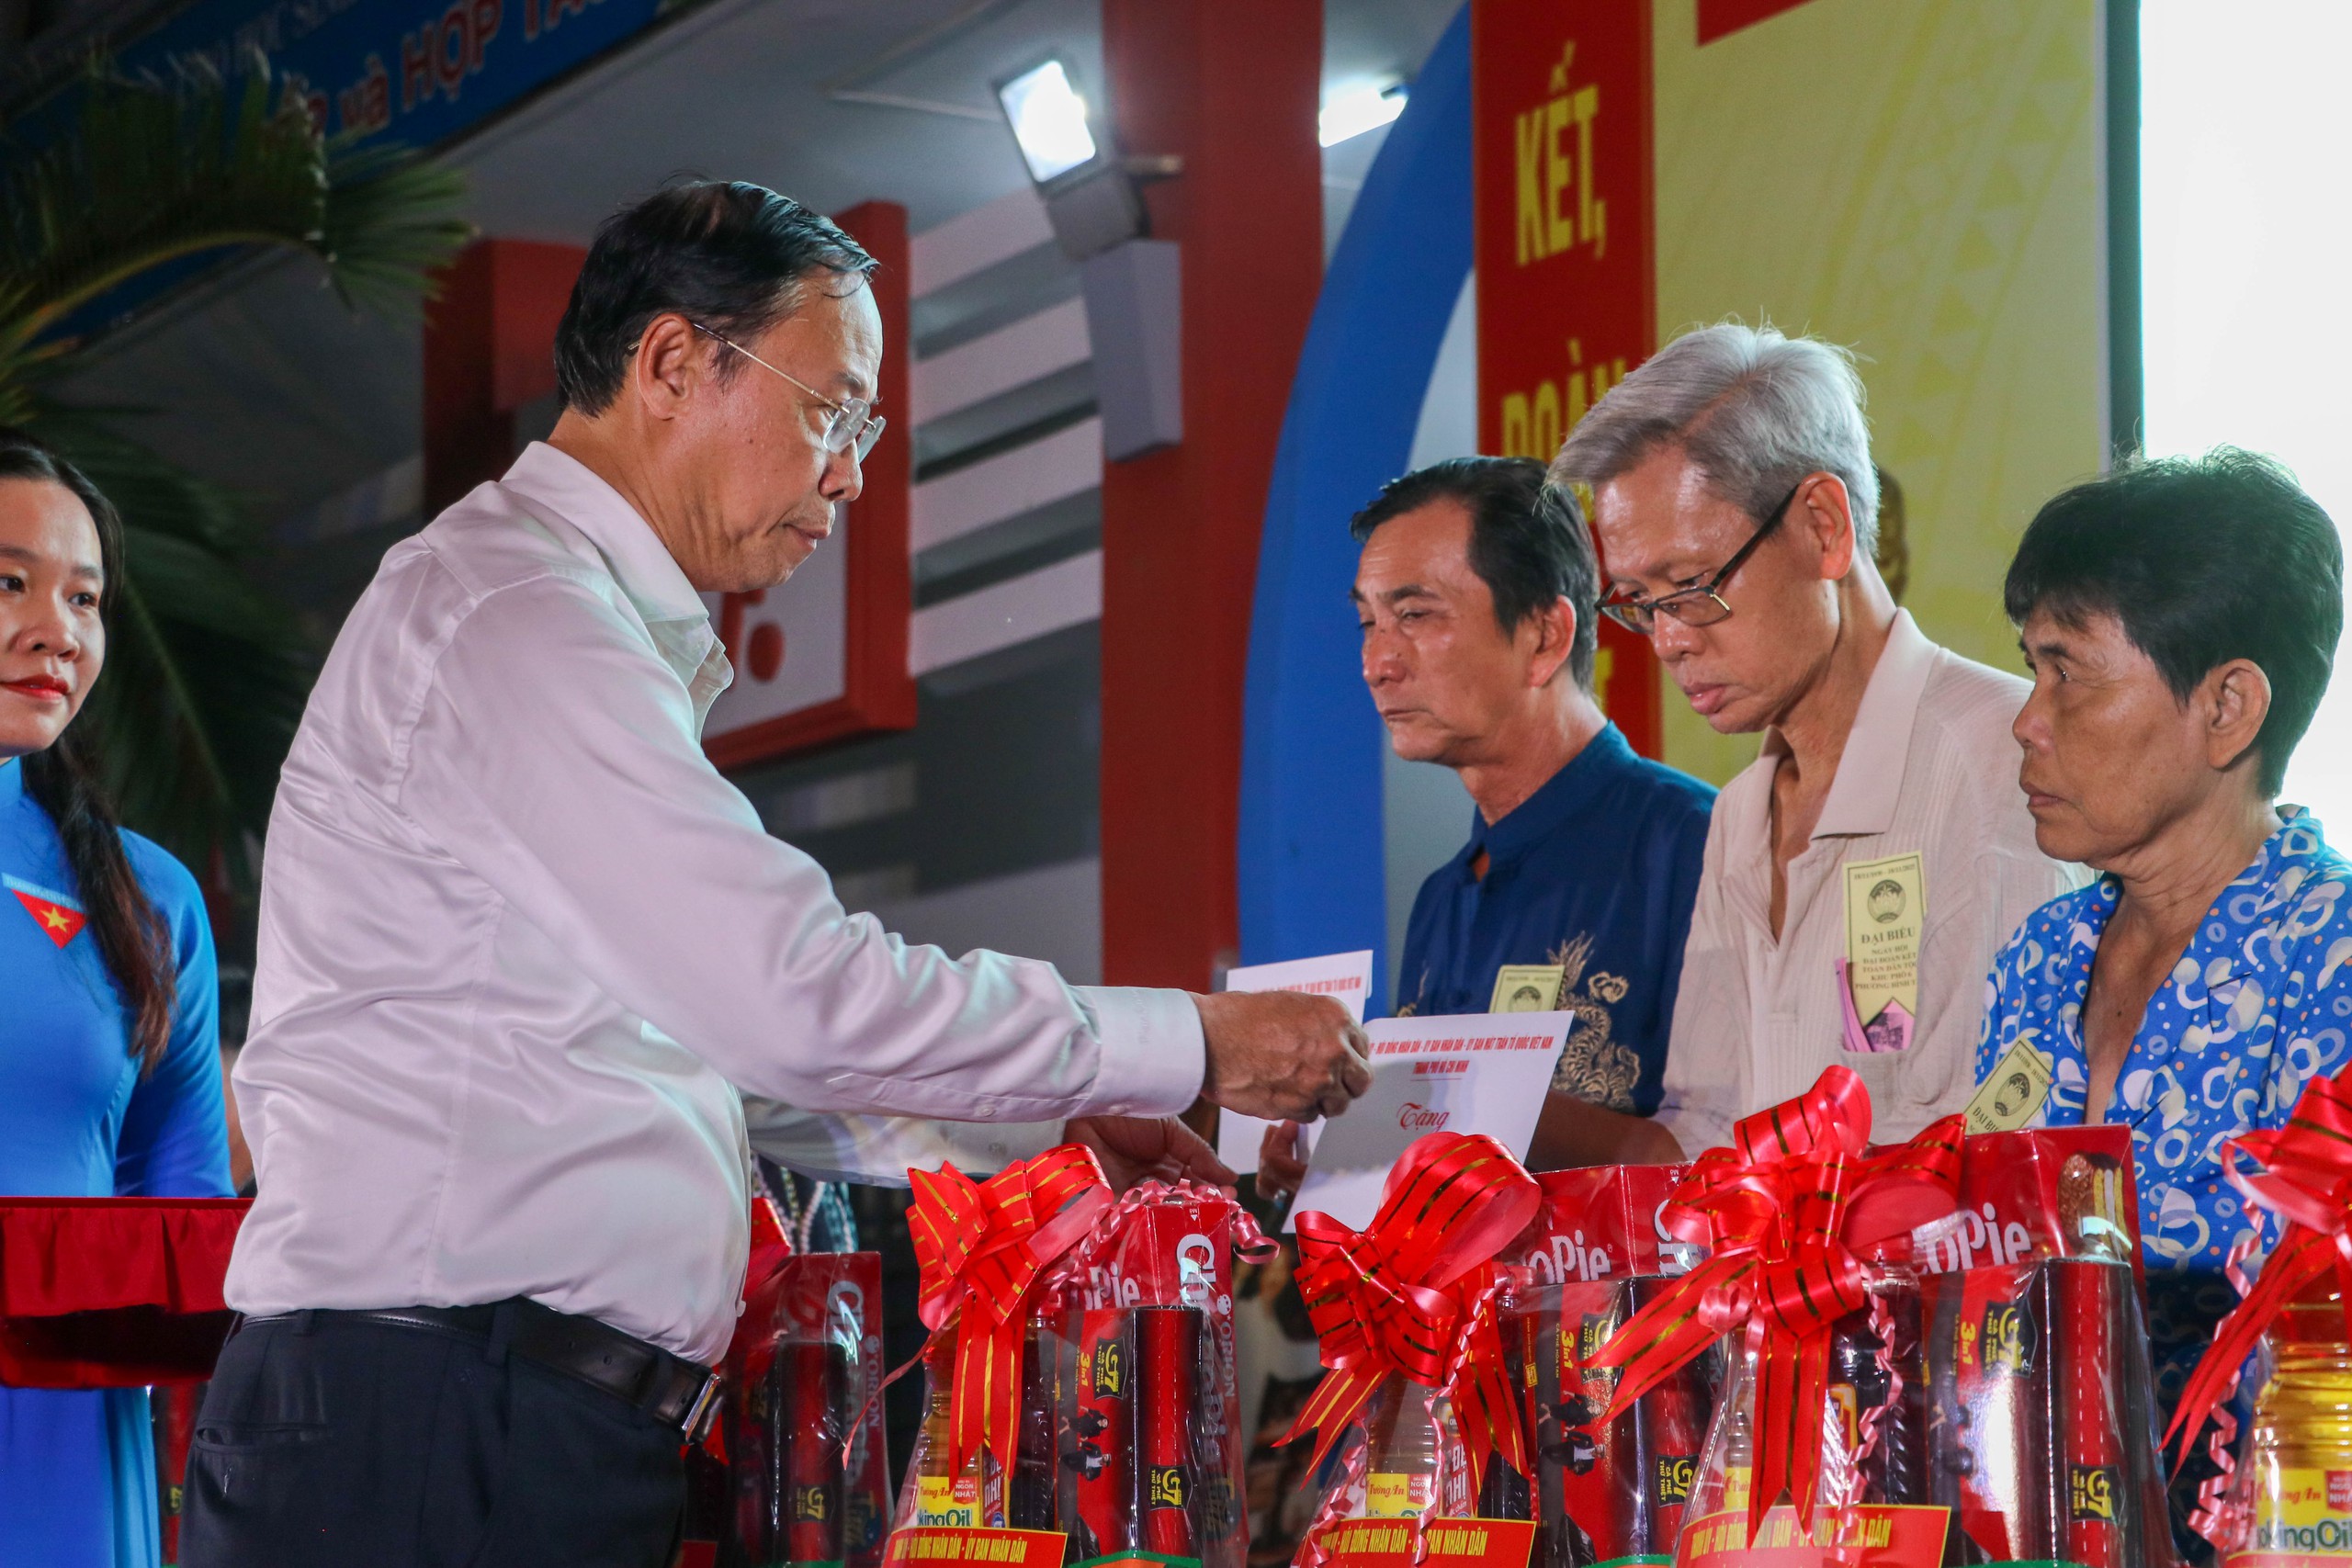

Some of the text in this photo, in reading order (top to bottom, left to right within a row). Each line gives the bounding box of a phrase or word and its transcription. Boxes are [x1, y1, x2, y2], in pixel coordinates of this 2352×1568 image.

[1514, 39, 1607, 267] KẾT,
[1860, 925, 1916, 946] ĐẠI BIỂU
[1540, 1036, 1555, 1050] NAM
[1396, 1102, 1451, 1133] Tặng
[1973, 1106, 1989, 1124] ĐẠI
[1524, 1229, 1612, 1285] oPie
[1218, 1321, 1236, 1397] ORION
[1561, 1329, 1575, 1369] 3in1
[1960, 1321, 1976, 1365] 3in1
[1080, 1351, 1091, 1387] 3in1
[1104, 1343, 1119, 1393] G7
[807, 1486, 826, 1520] G7
[955, 1488, 977, 1498] NHẤT
[1161, 1469, 1182, 1506] G7
[2086, 1470, 2112, 1517] G7
[931, 1532, 950, 1559] NHÂN
[946, 1532, 963, 1560] DÂN
[964, 1530, 977, 1561] ỦY
[974, 1538, 991, 1562] BAN
[988, 1535, 1012, 1562] NHÂN
[1009, 1536, 1028, 1563] DÂN
[1350, 1521, 1371, 1553] ĐỒNG
[1368, 1524, 1392, 1553] NHÂN
[1389, 1524, 1409, 1553] DÂN
[1442, 1525, 1469, 1556] NHÂN
[1466, 1526, 1488, 1556] DÂN
